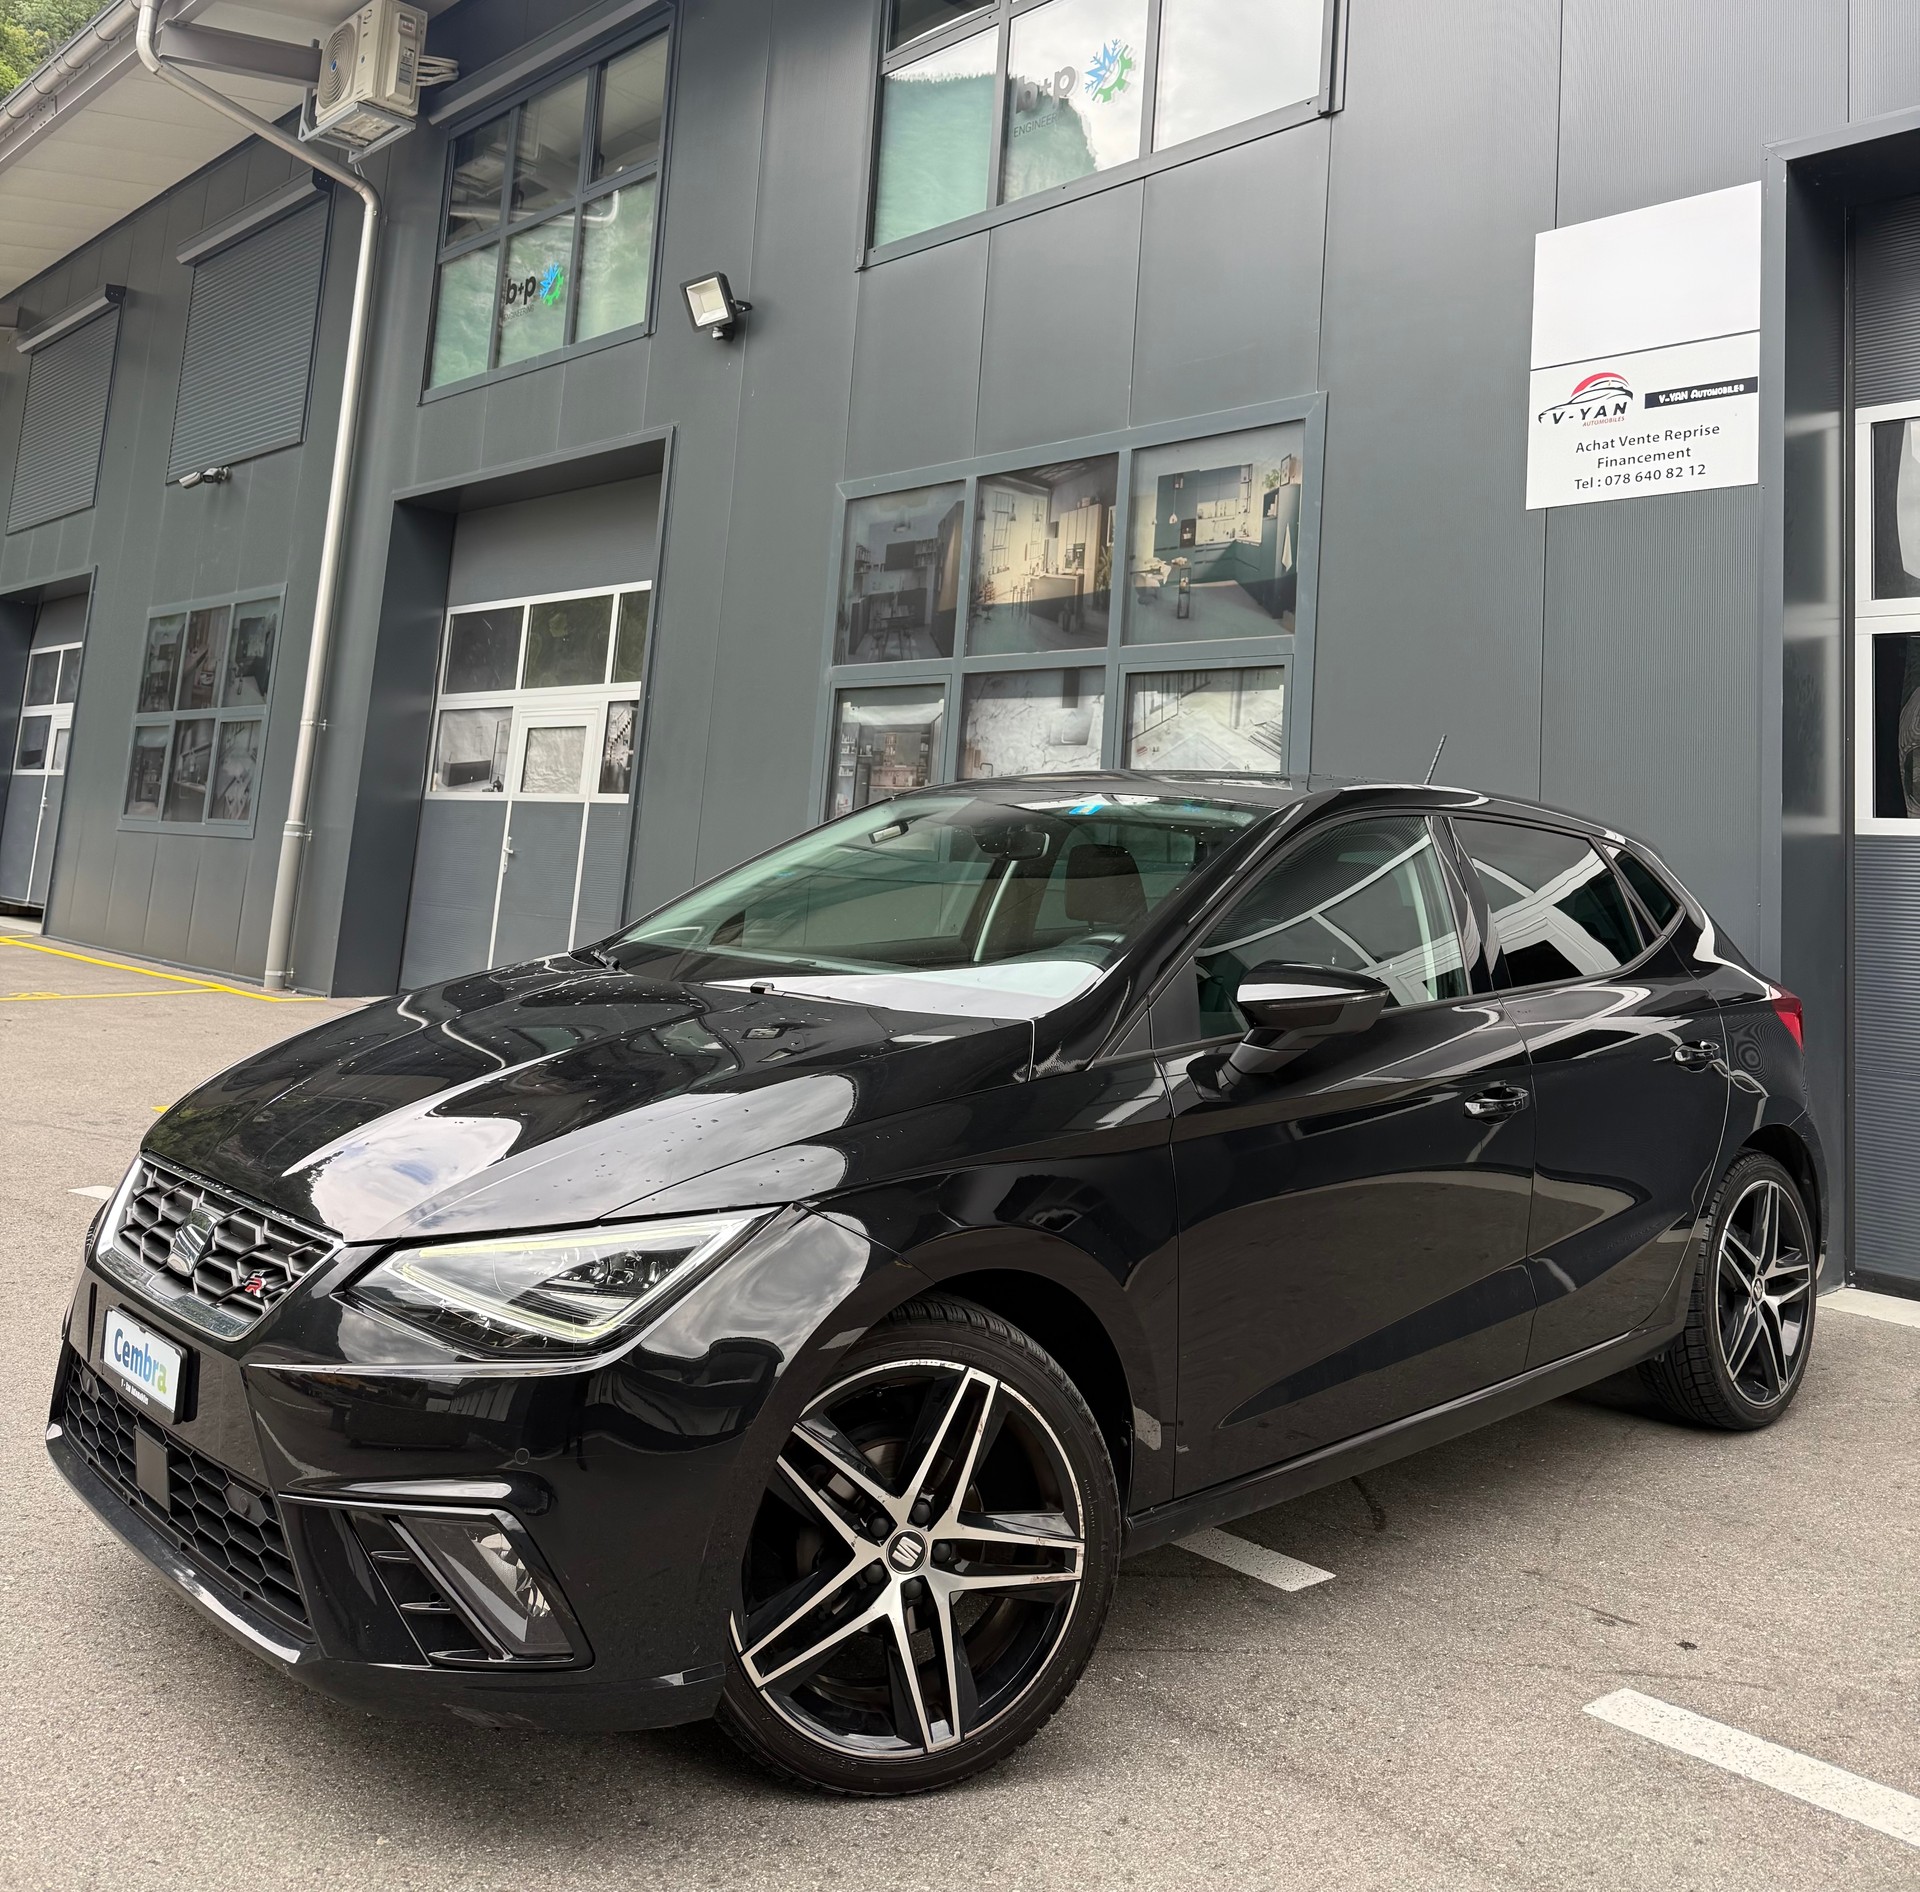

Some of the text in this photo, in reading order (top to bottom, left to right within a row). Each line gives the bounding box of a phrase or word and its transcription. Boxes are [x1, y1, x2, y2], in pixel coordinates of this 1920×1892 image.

[505, 276, 537, 305] b+p
[1552, 402, 1627, 425] V-YAN
[1582, 416, 1625, 428] AUTOMOBILES
[1575, 424, 1720, 453] Achat Vente Reprise
[1597, 447, 1692, 469] Financement
[1604, 473, 1631, 486] 078
[1635, 469, 1662, 483] 640
[1666, 466, 1683, 479] 82
[1689, 464, 1706, 476] 12
[114, 1328, 167, 1394] Cembra
